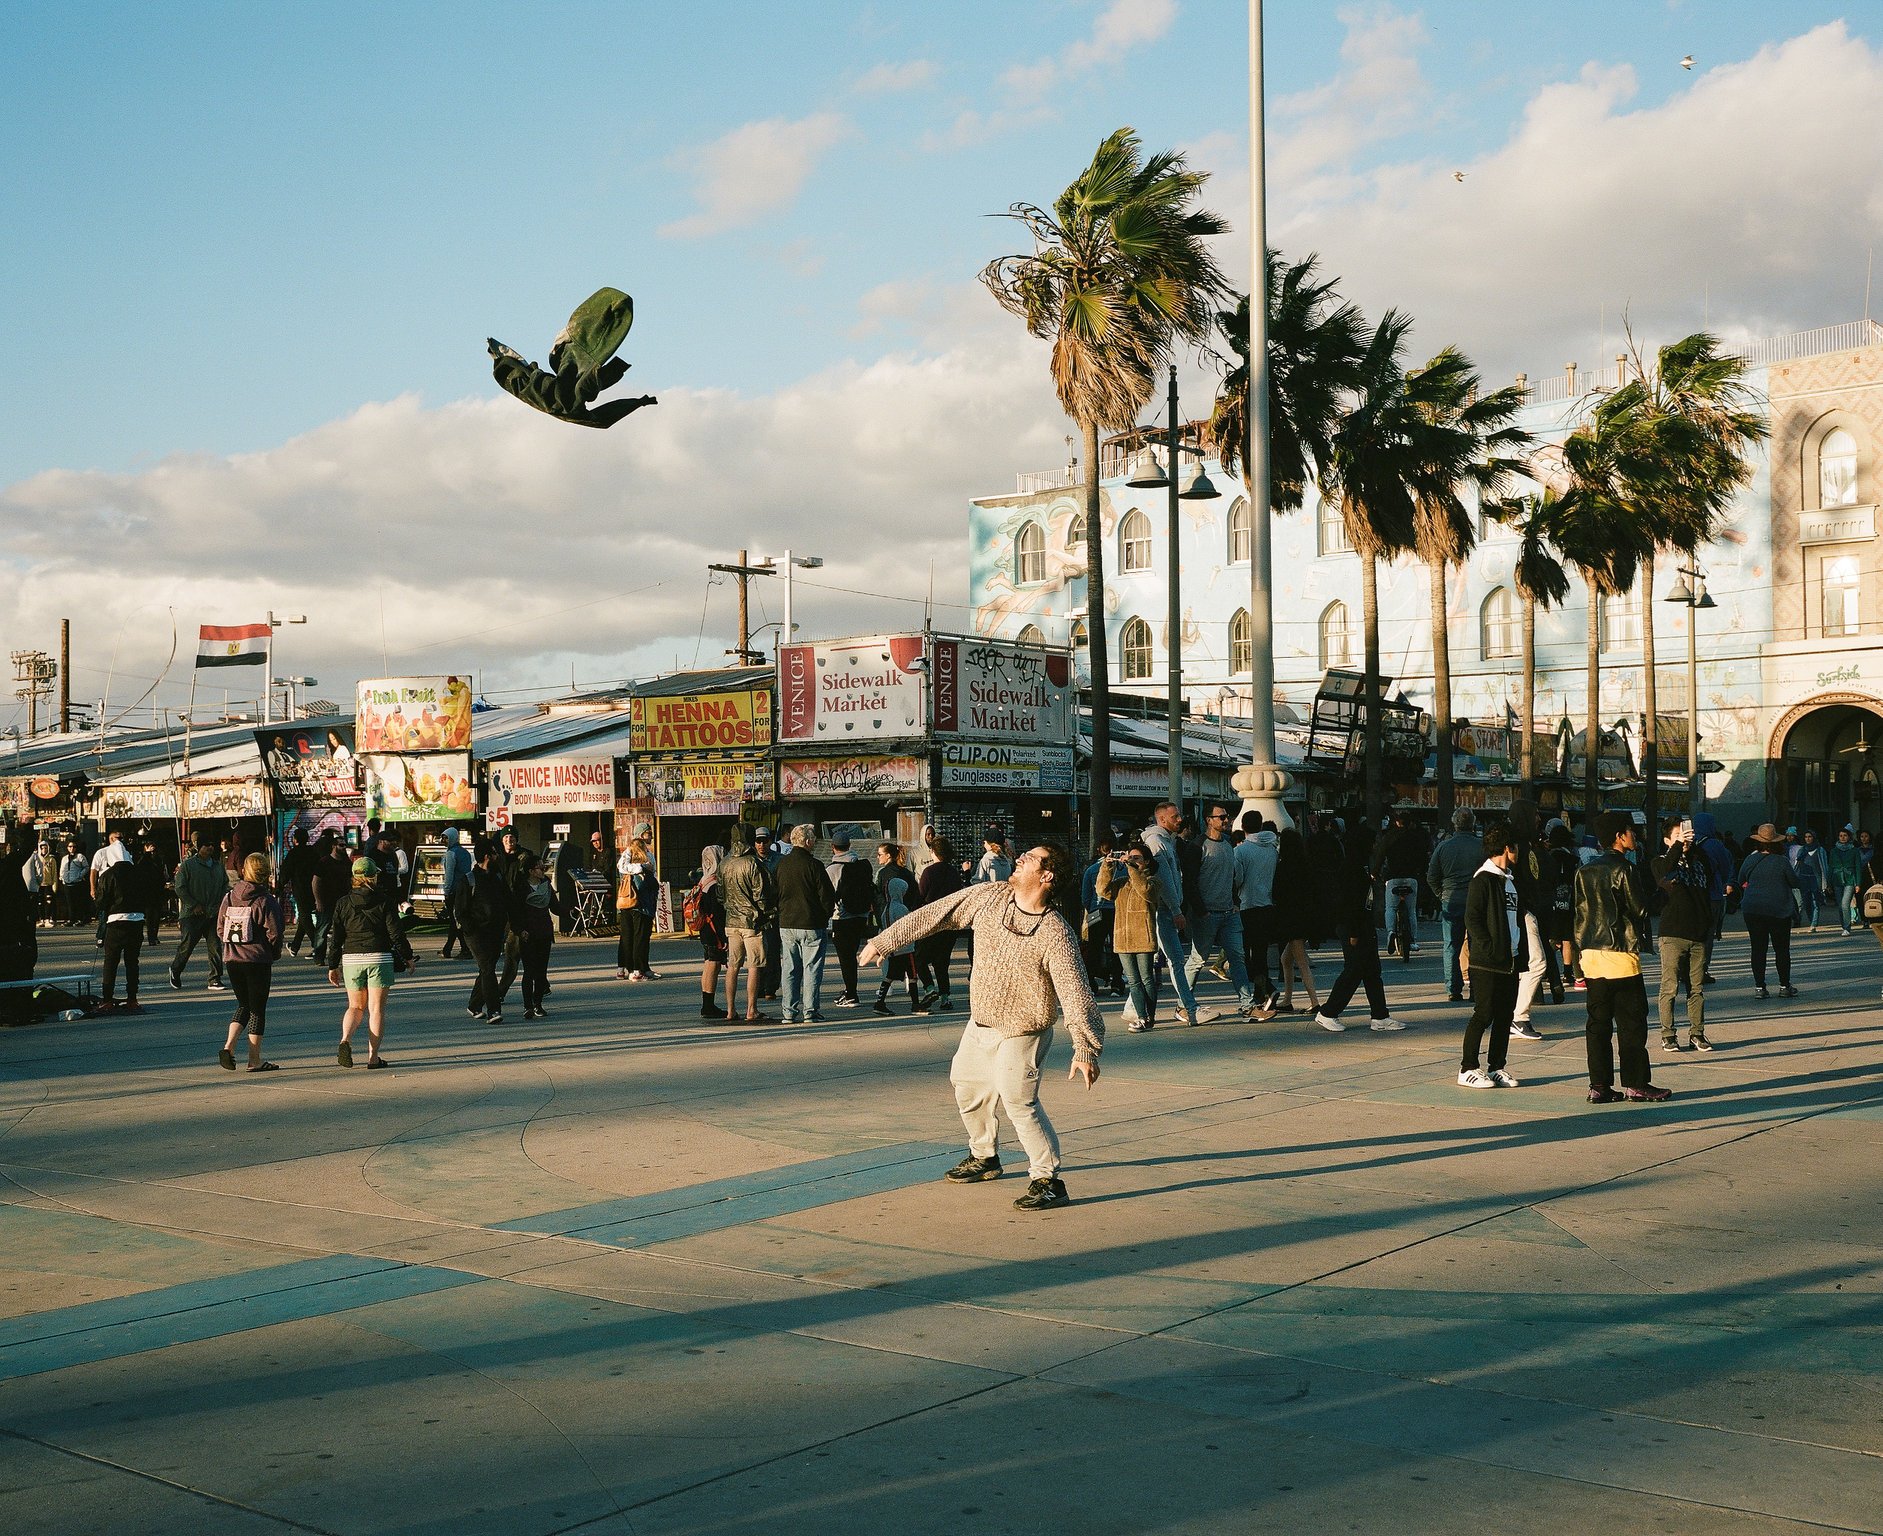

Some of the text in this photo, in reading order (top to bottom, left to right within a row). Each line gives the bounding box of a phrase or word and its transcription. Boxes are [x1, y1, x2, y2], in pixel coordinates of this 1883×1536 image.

[823, 669, 902, 691] Sidewalk
[940, 648, 952, 723] VENICE
[756, 691, 768, 714] 2
[790, 652, 804, 733] VENICE
[823, 694, 887, 712] Market
[970, 680, 1052, 708] Sidewalk
[633, 699, 643, 720] 2
[657, 701, 739, 723] HENNA
[970, 707, 1036, 732] Market
[632, 724, 644, 732] FOR
[755, 718, 769, 726] FOR
[632, 735, 645, 748] $10
[647, 721, 752, 748] TATTOOS
[755, 729, 770, 742] $10
[1476, 729, 1502, 751] STORE
[947, 745, 1011, 766] CLIP-ON
[509, 764, 611, 789] VENICE MASSAGE
[683, 765, 743, 776] ANY SMALL PRINT
[951, 768, 1007, 785] Sunglasses
[324, 778, 355, 795] RENTAL
[691, 775, 735, 789] ONLY $5
[106, 789, 177, 813] EGYPTIAN
[514, 793, 560, 806] BODY Massage
[564, 792, 610, 805] FOOT Massage
[488, 807, 509, 828] $5
